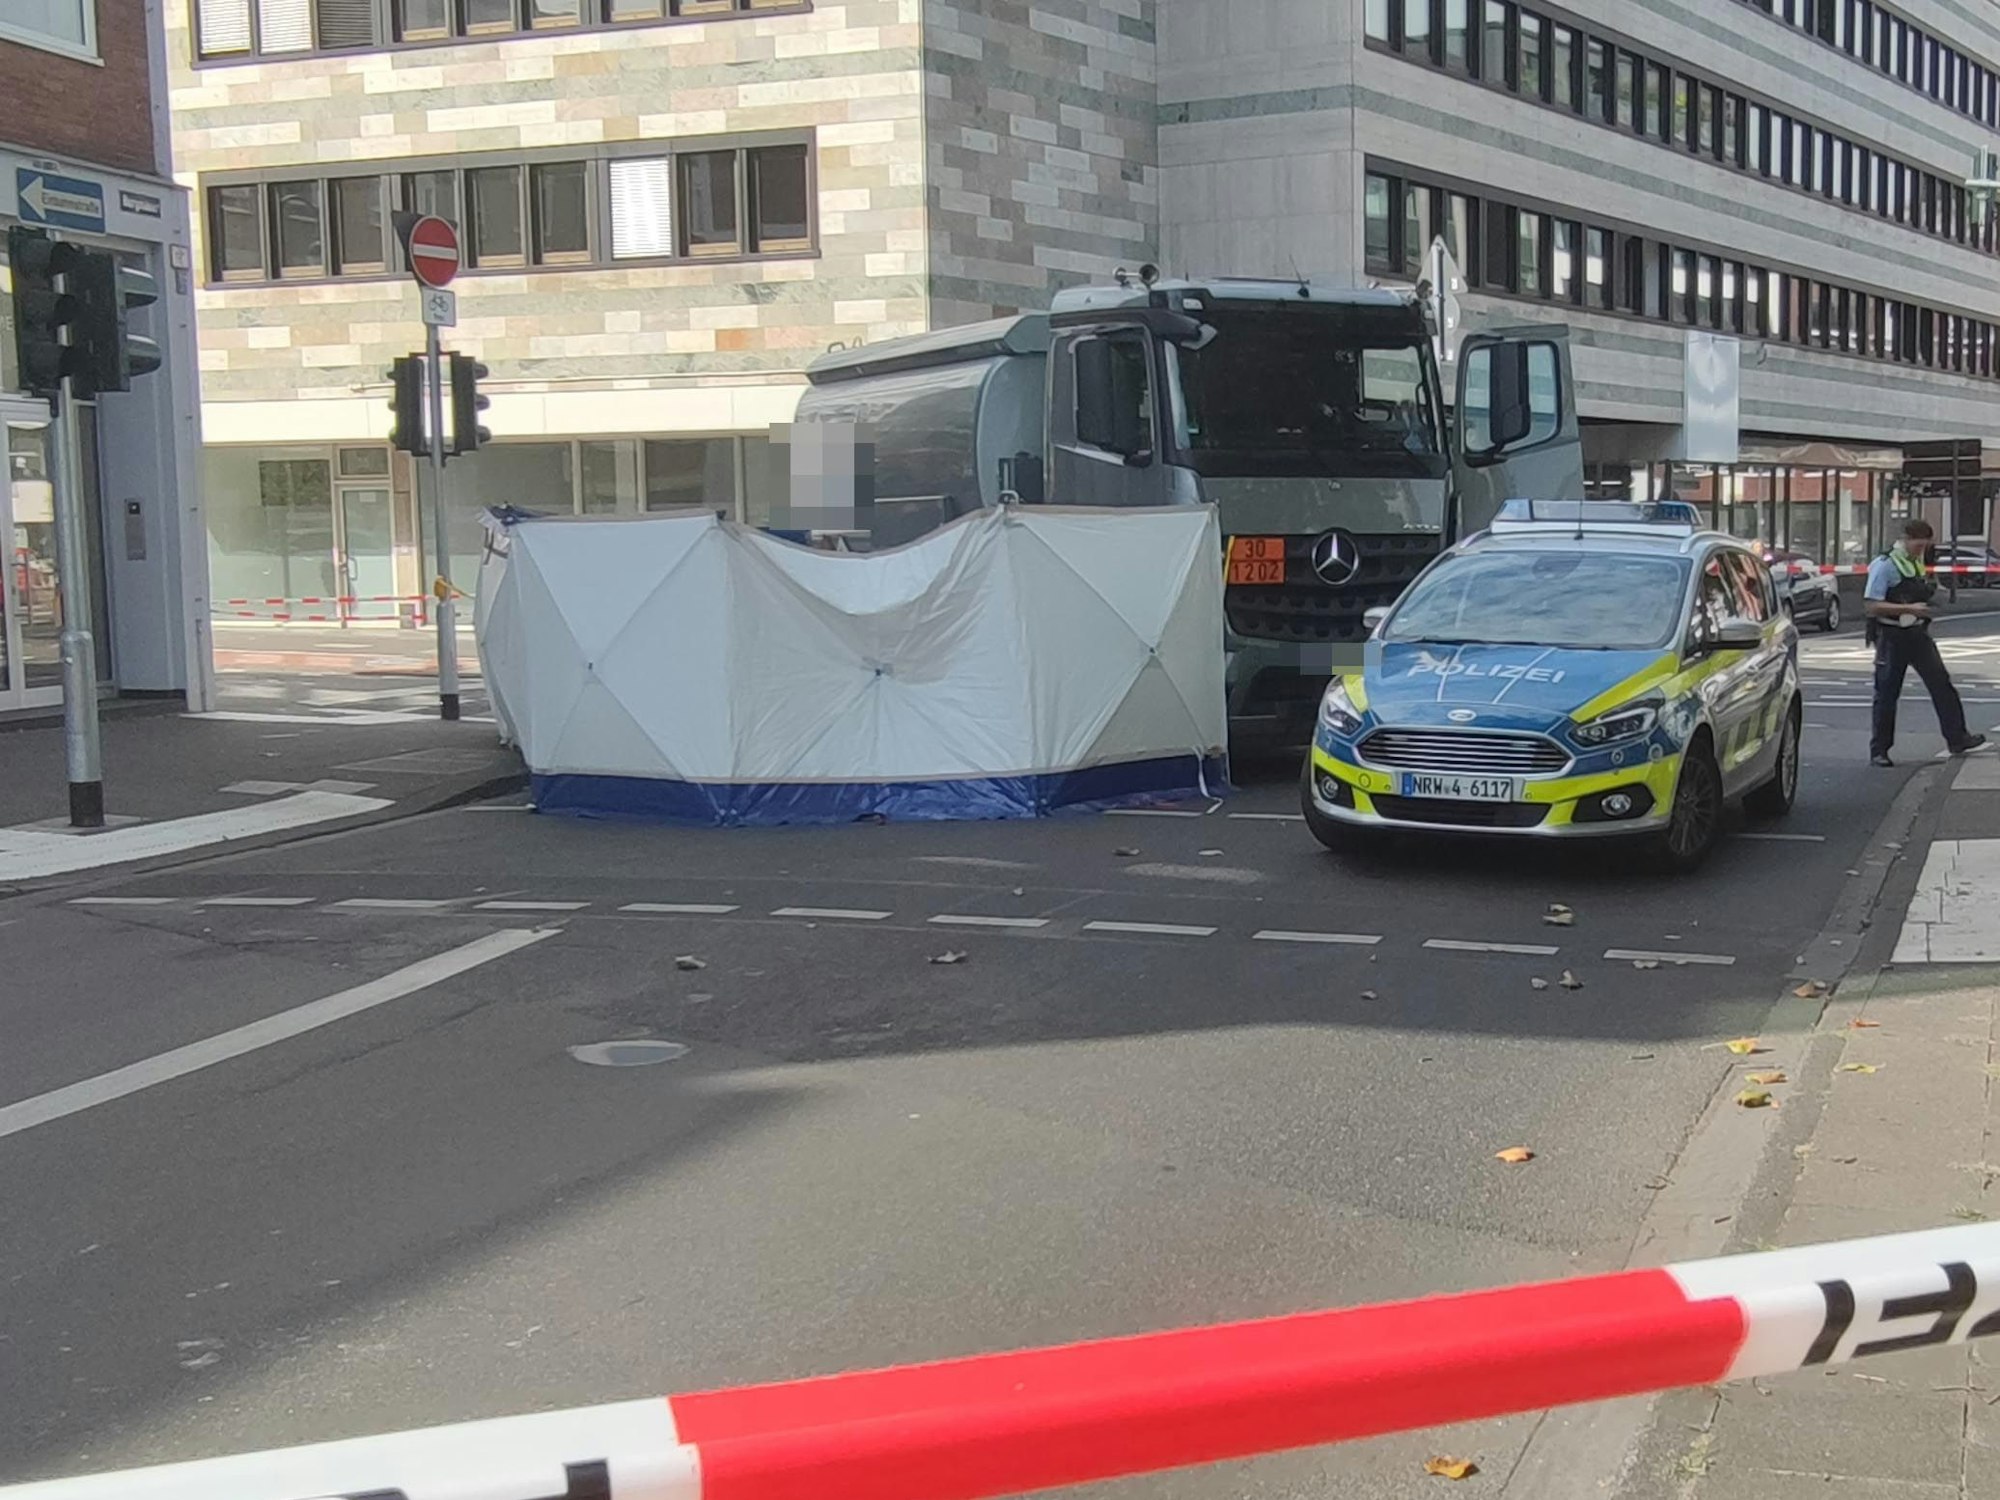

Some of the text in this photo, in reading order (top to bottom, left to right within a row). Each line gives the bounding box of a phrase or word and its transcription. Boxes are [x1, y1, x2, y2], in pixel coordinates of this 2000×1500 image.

[1245, 540, 1266, 558] 30
[1234, 562, 1279, 581] 1202
[1406, 663, 1565, 684] POLIZEI
[1412, 776, 1443, 795] NRW
